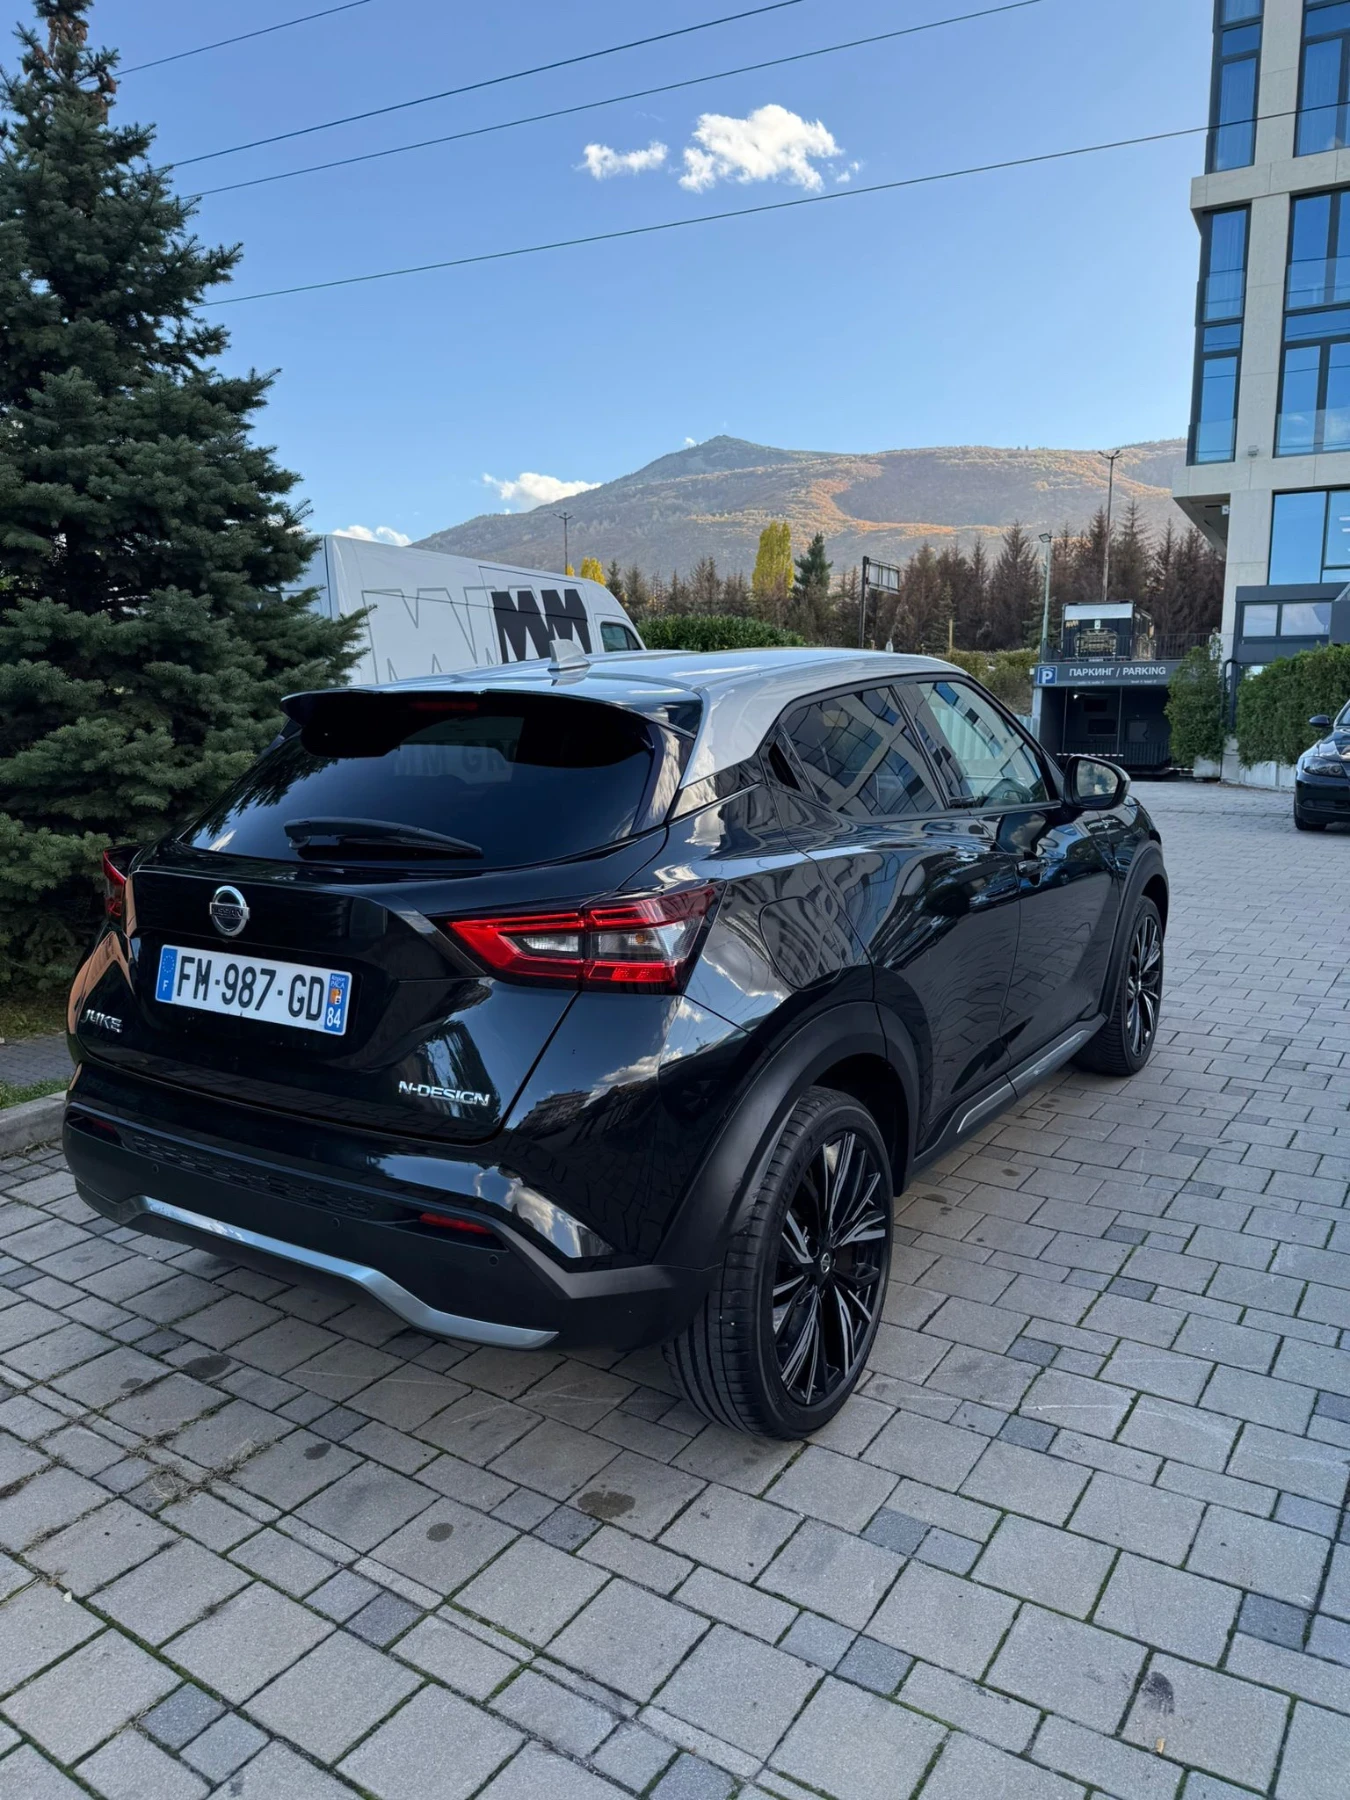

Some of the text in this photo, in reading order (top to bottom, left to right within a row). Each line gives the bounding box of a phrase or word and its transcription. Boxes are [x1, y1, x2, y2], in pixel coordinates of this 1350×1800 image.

[1042, 671, 1053, 684] P
[1069, 666, 1166, 678] ПАРКИНГ / PARKING
[162, 980, 169, 991] F
[80, 1008, 123, 1033] JUKE
[326, 1007, 341, 1028] 84
[398, 1080, 490, 1107] N-DESIGN
